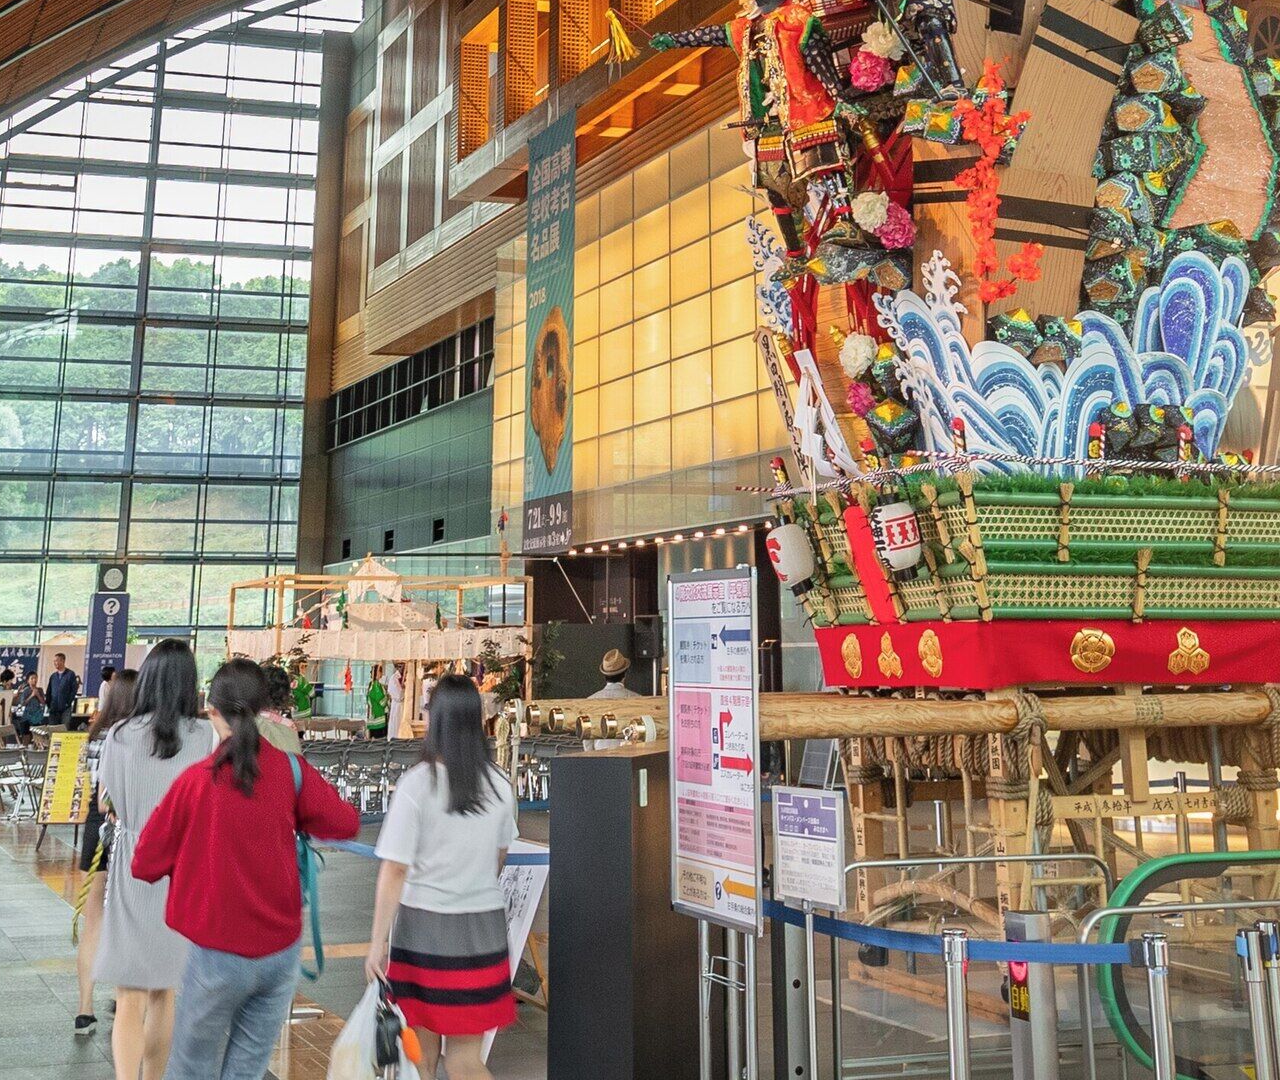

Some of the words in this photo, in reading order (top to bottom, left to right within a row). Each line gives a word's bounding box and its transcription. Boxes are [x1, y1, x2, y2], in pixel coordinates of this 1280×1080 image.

[532, 143, 571, 194] 全国高等
[531, 180, 570, 228] 学校考古
[531, 221, 560, 264] 名品展
[529, 287, 547, 309] 2018
